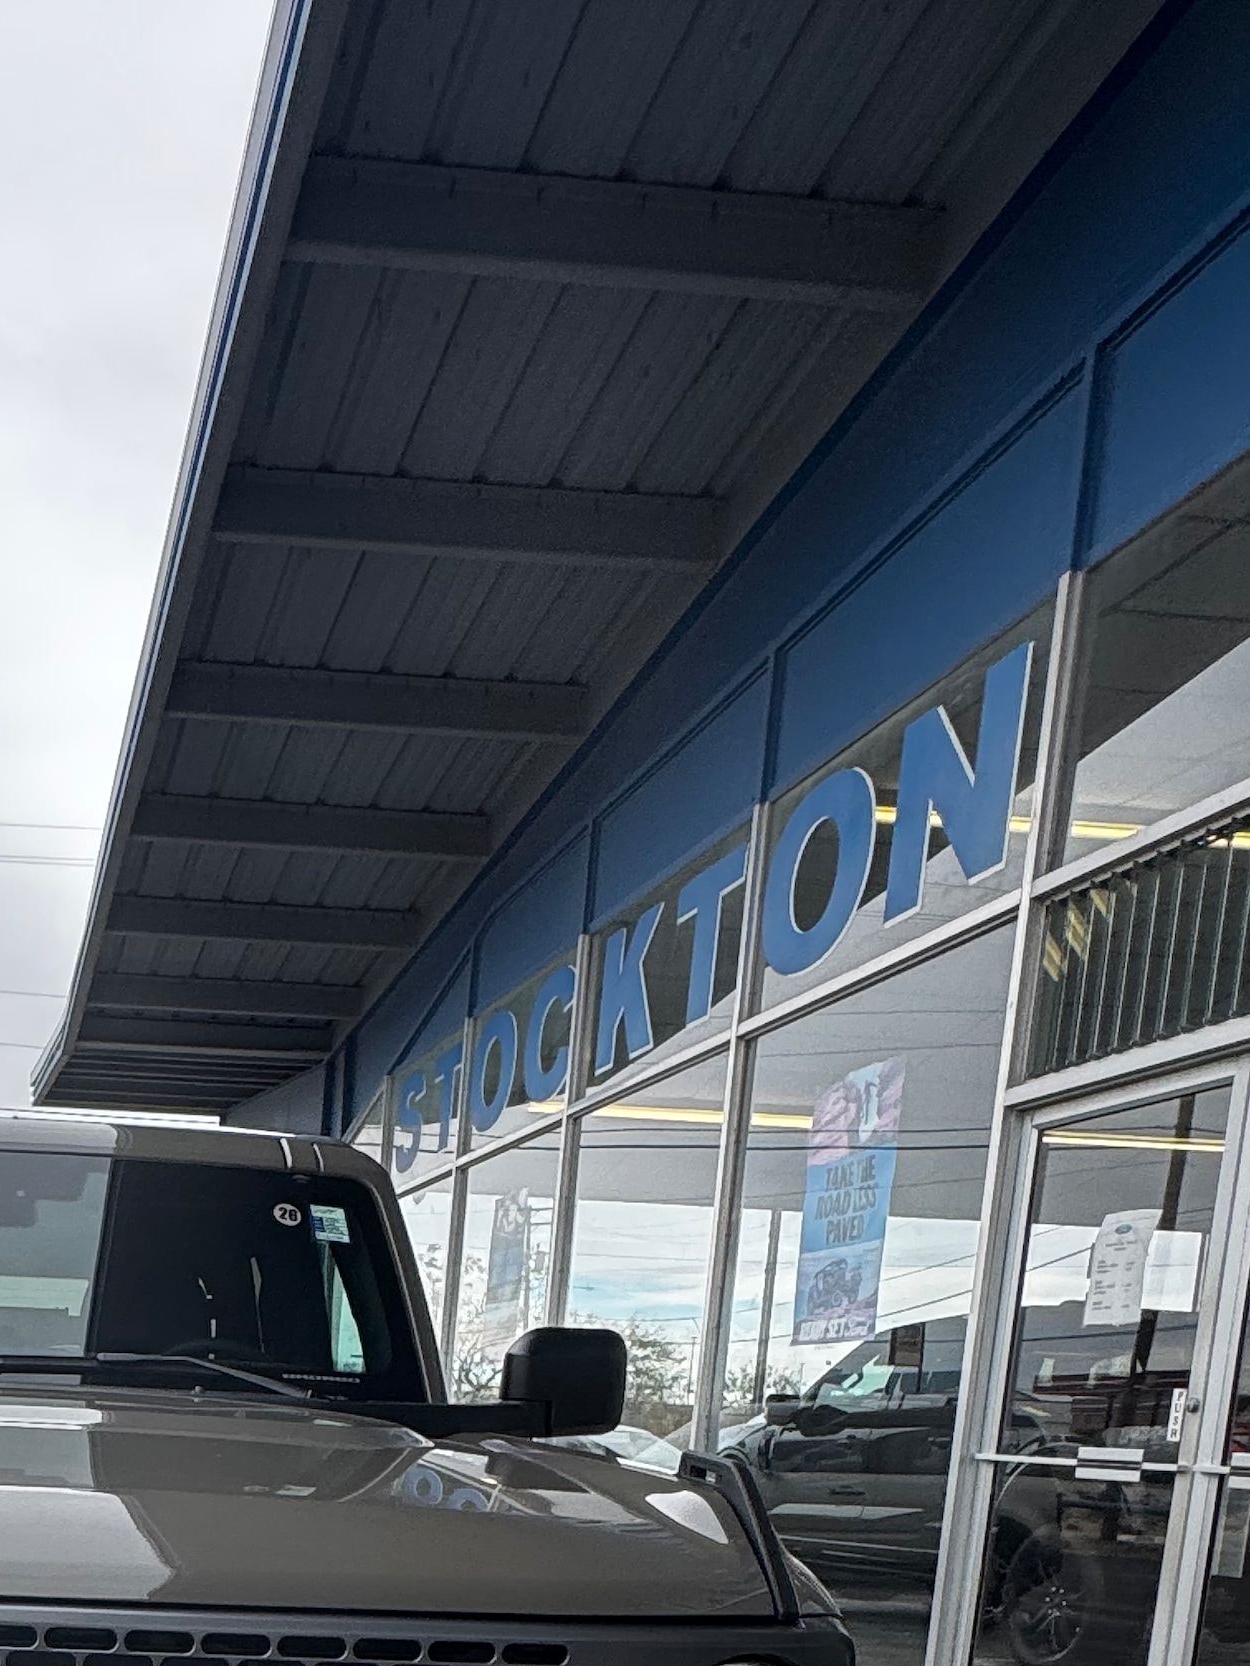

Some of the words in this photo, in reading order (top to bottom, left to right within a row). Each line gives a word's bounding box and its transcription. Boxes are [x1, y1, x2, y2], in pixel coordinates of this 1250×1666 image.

[395, 640, 1035, 1173] STOCKTON
[826, 1161, 855, 1192] TAKE
[856, 1154, 876, 1183] THE
[815, 1189, 851, 1220] ROAD
[826, 1214, 864, 1246] PAVED
[1170, 1391, 1184, 1439] PUSH
